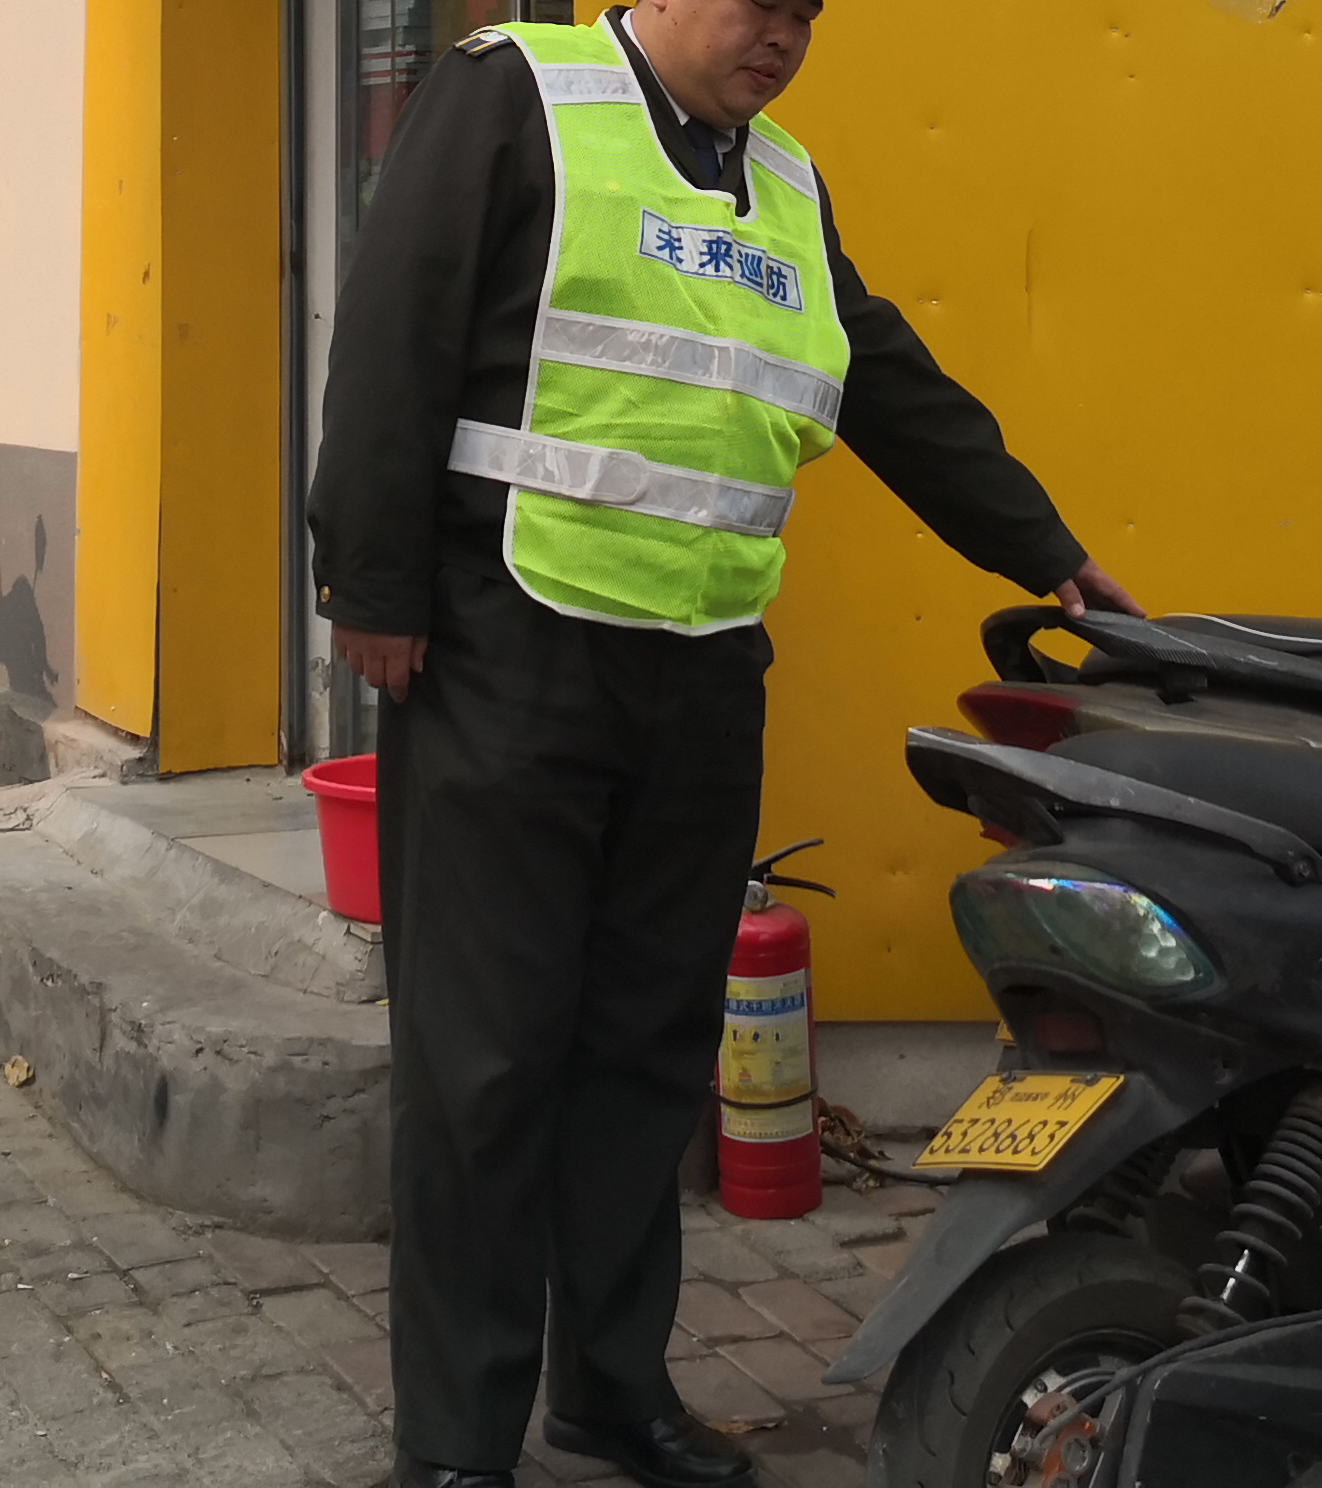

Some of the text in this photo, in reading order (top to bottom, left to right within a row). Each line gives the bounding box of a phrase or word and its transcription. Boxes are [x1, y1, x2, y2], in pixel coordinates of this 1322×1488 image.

[654, 225, 789, 303] 未来巡防
[927, 1117, 1070, 1157] 5328683
